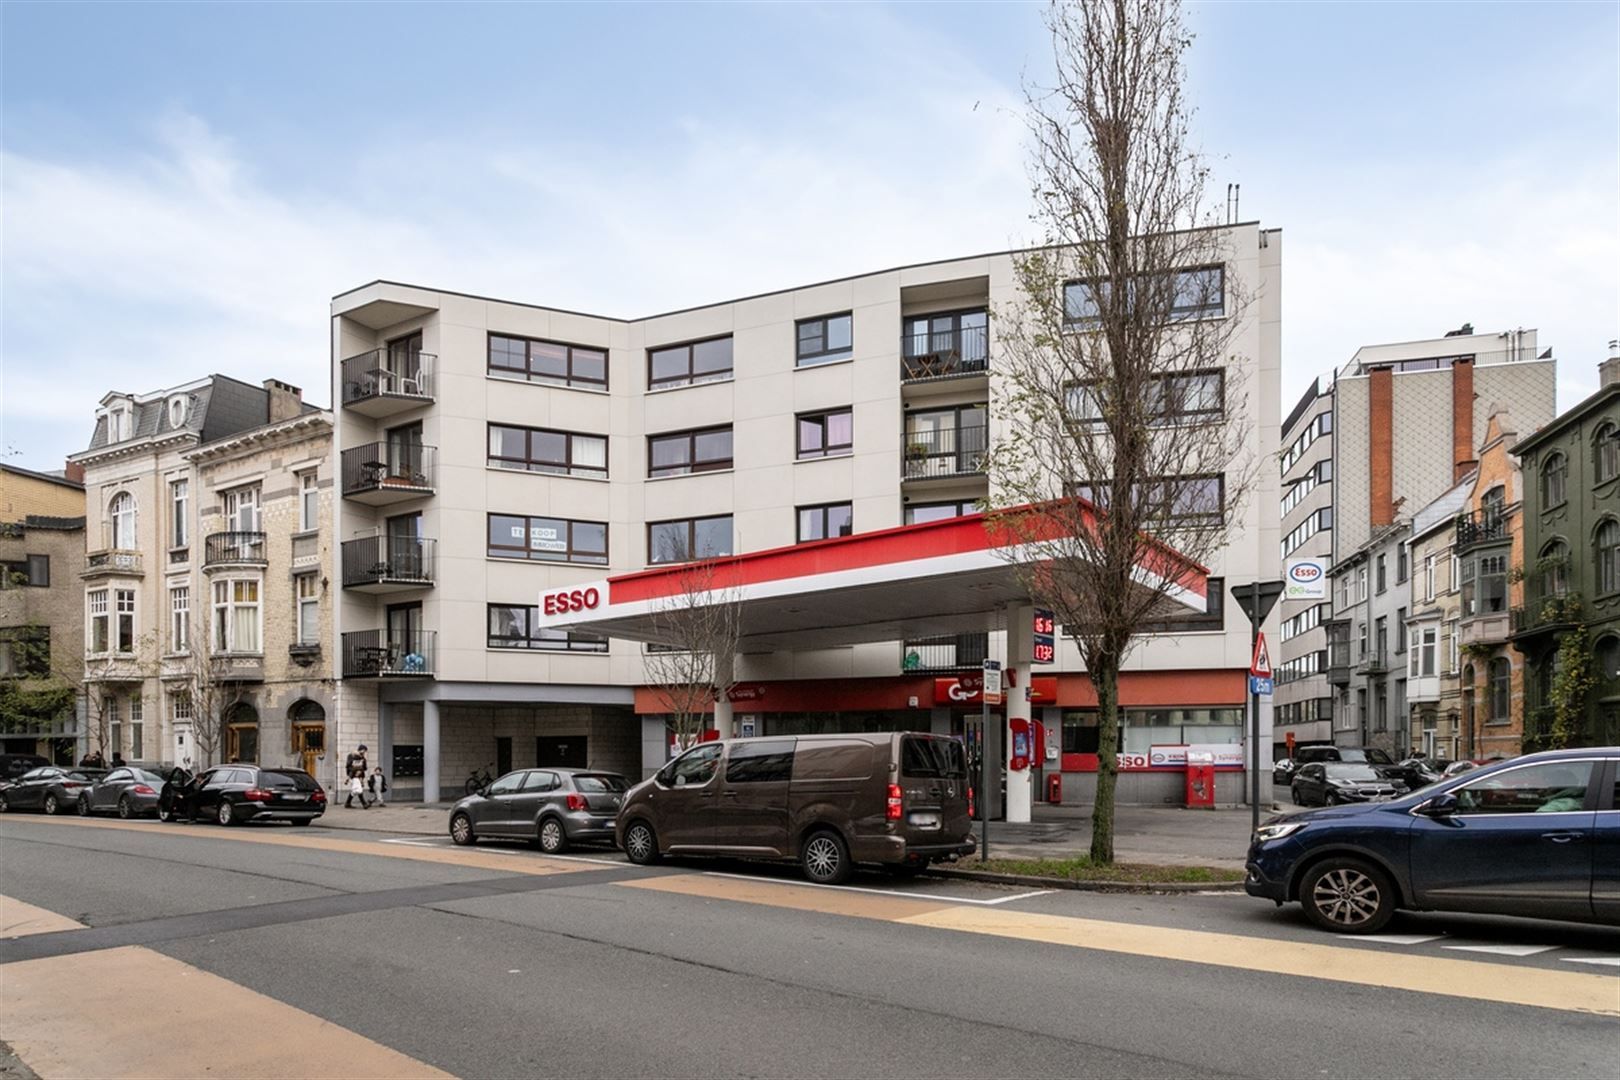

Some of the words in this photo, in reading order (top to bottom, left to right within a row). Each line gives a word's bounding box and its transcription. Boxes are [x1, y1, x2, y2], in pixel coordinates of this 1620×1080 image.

[513, 529, 523, 537] TE
[532, 529, 555, 538] KOOP
[544, 587, 599, 616] ESSO
[1116, 756, 1145, 767] SSO
